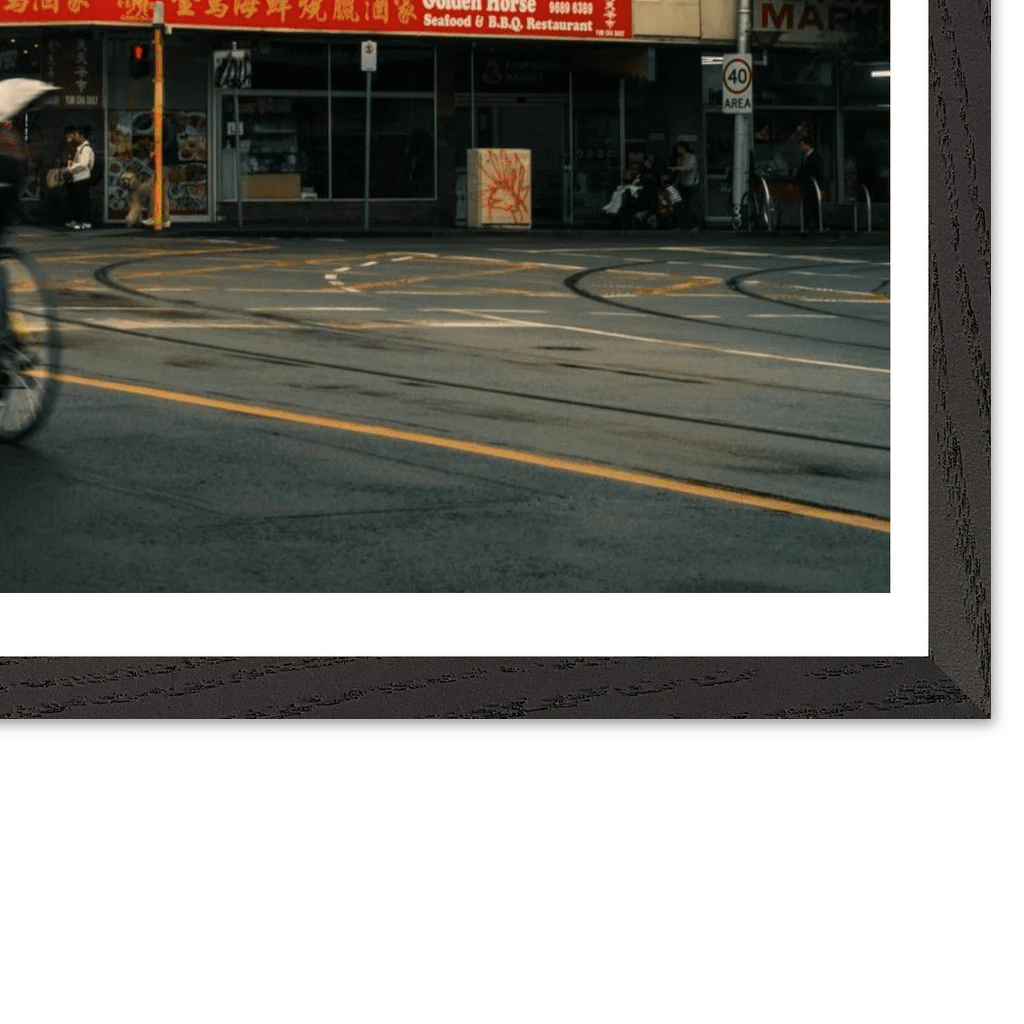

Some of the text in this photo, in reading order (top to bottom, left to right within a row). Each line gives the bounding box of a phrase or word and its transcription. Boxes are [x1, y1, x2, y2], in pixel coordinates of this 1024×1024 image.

[423, 13, 472, 28] Seafood
[475, 14, 484, 28] &
[526, 17, 593, 32] Restaurant
[727, 68, 748, 85] 40
[724, 98, 752, 109] AREA
